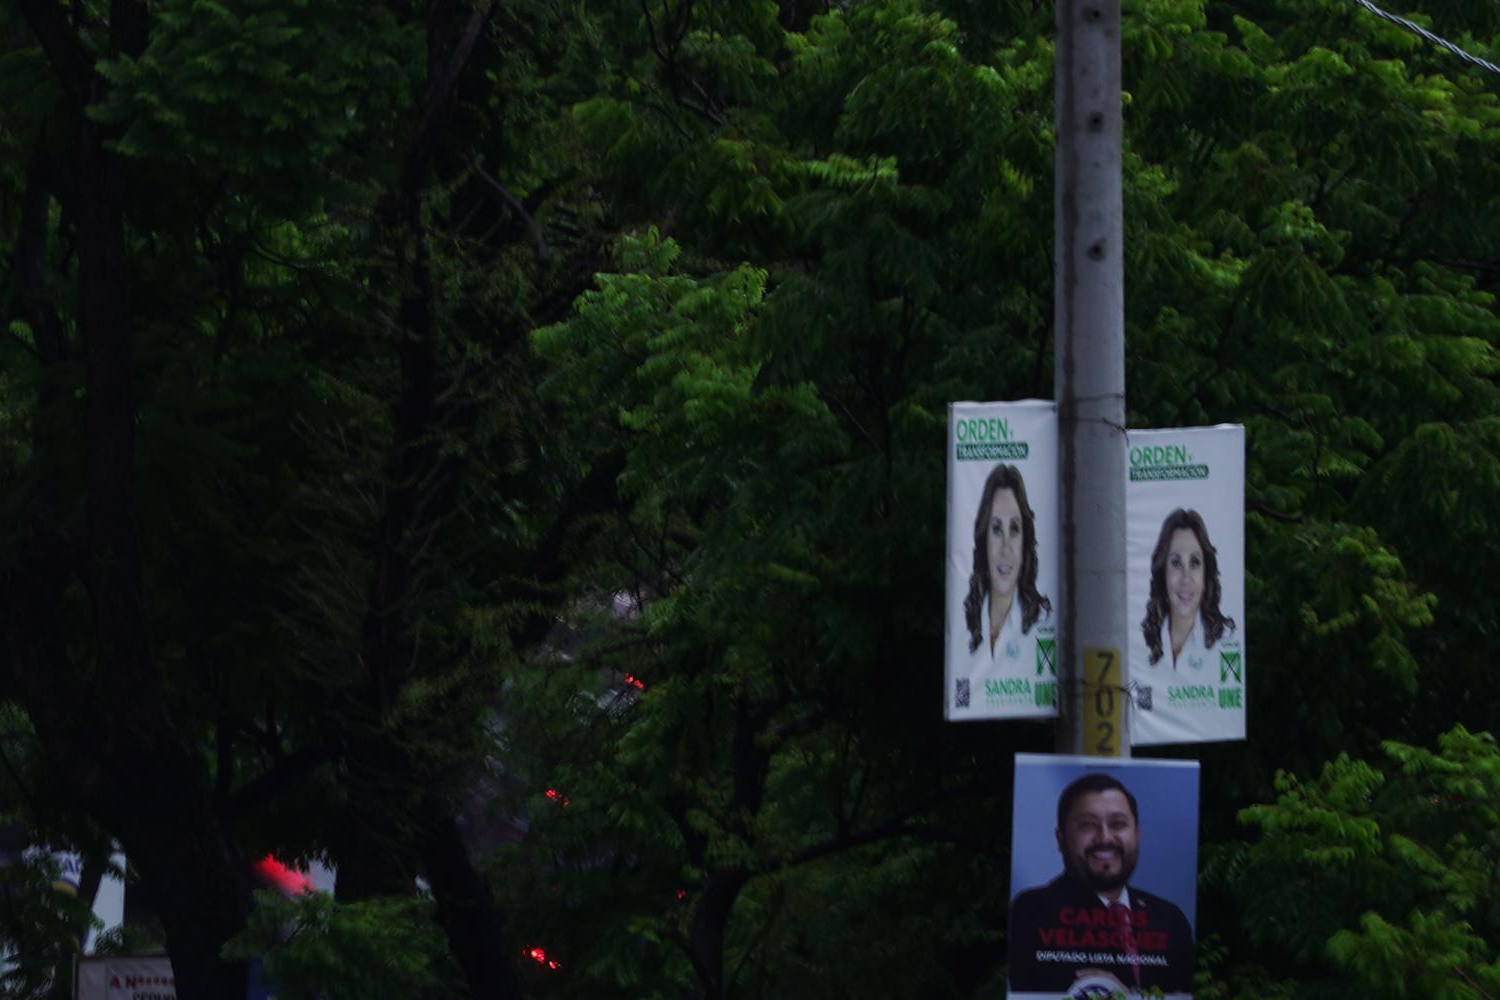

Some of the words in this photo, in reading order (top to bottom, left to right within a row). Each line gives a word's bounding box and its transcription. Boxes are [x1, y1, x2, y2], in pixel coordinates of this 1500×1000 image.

[956, 418, 1008, 442] ORDEN
[1130, 446, 1186, 466] ORDEN
[985, 679, 1031, 696] SANDRA
[1167, 686, 1214, 699] SANDRA
[1219, 687, 1242, 708] UNE
